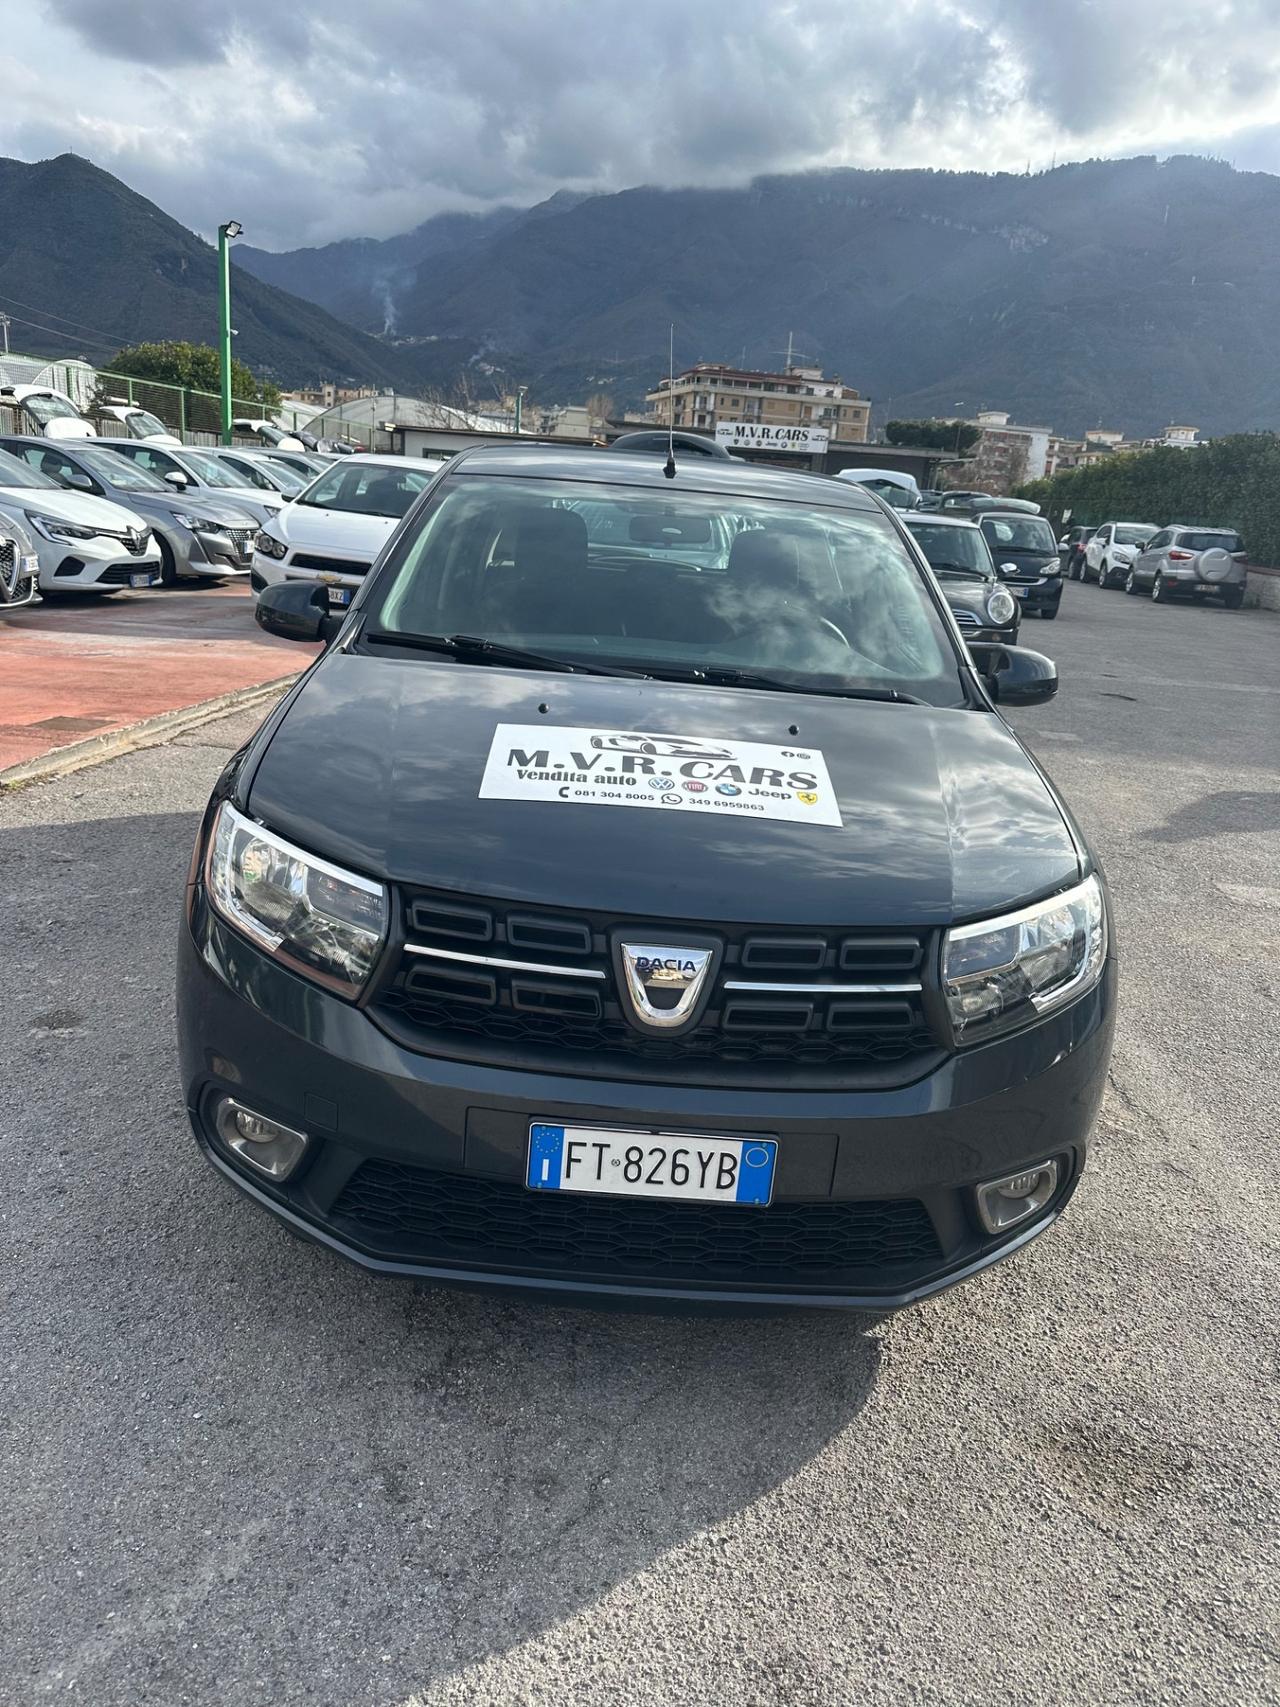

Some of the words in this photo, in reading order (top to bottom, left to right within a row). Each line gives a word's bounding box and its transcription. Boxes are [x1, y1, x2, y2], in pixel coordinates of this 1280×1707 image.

[517, 769, 588, 783] Vendita
[594, 774, 637, 786] auto
[600, 791, 622, 799] 304
[625, 793, 655, 801] 8005
[748, 788, 792, 801] Jeep
[689, 798, 711, 806] 349
[637, 957, 696, 972] DACIA
